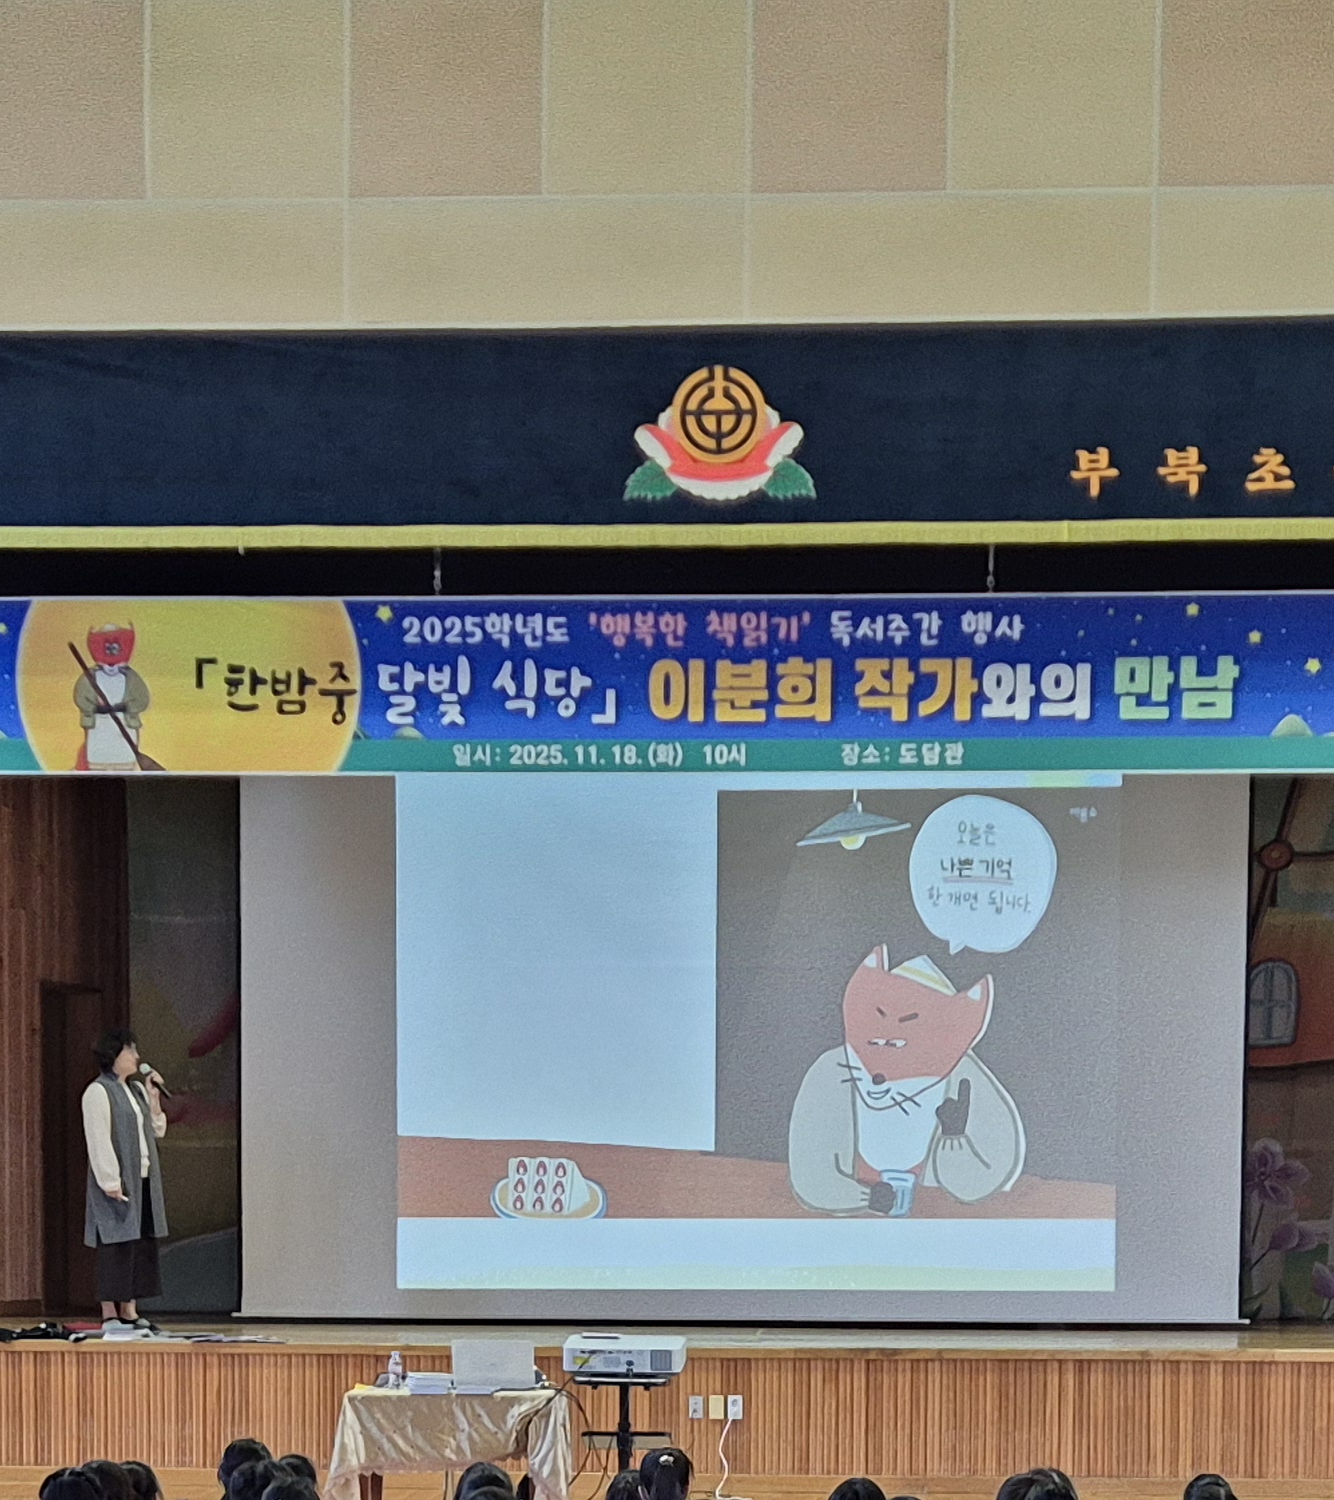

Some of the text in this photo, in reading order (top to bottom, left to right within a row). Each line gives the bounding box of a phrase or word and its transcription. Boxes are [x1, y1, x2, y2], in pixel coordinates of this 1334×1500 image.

[402, 611, 570, 649] 2025학년도
[830, 609, 943, 647] 독서주간
[961, 609, 1025, 646] 행사
[195, 654, 1240, 727] 「한밤중 달빛 식당」 이분희 작가와의 만남
[453, 743, 501, 767] 일시:
[702, 743, 747, 767] 10시
[841, 742, 890, 766] 장소:
[898, 741, 964, 766] 도담관
[957, 820, 996, 846] 오늘은
[940, 857, 1012, 880] 나쁜 기억
[927, 885, 941, 907] 한
[949, 891, 979, 911] 개면
